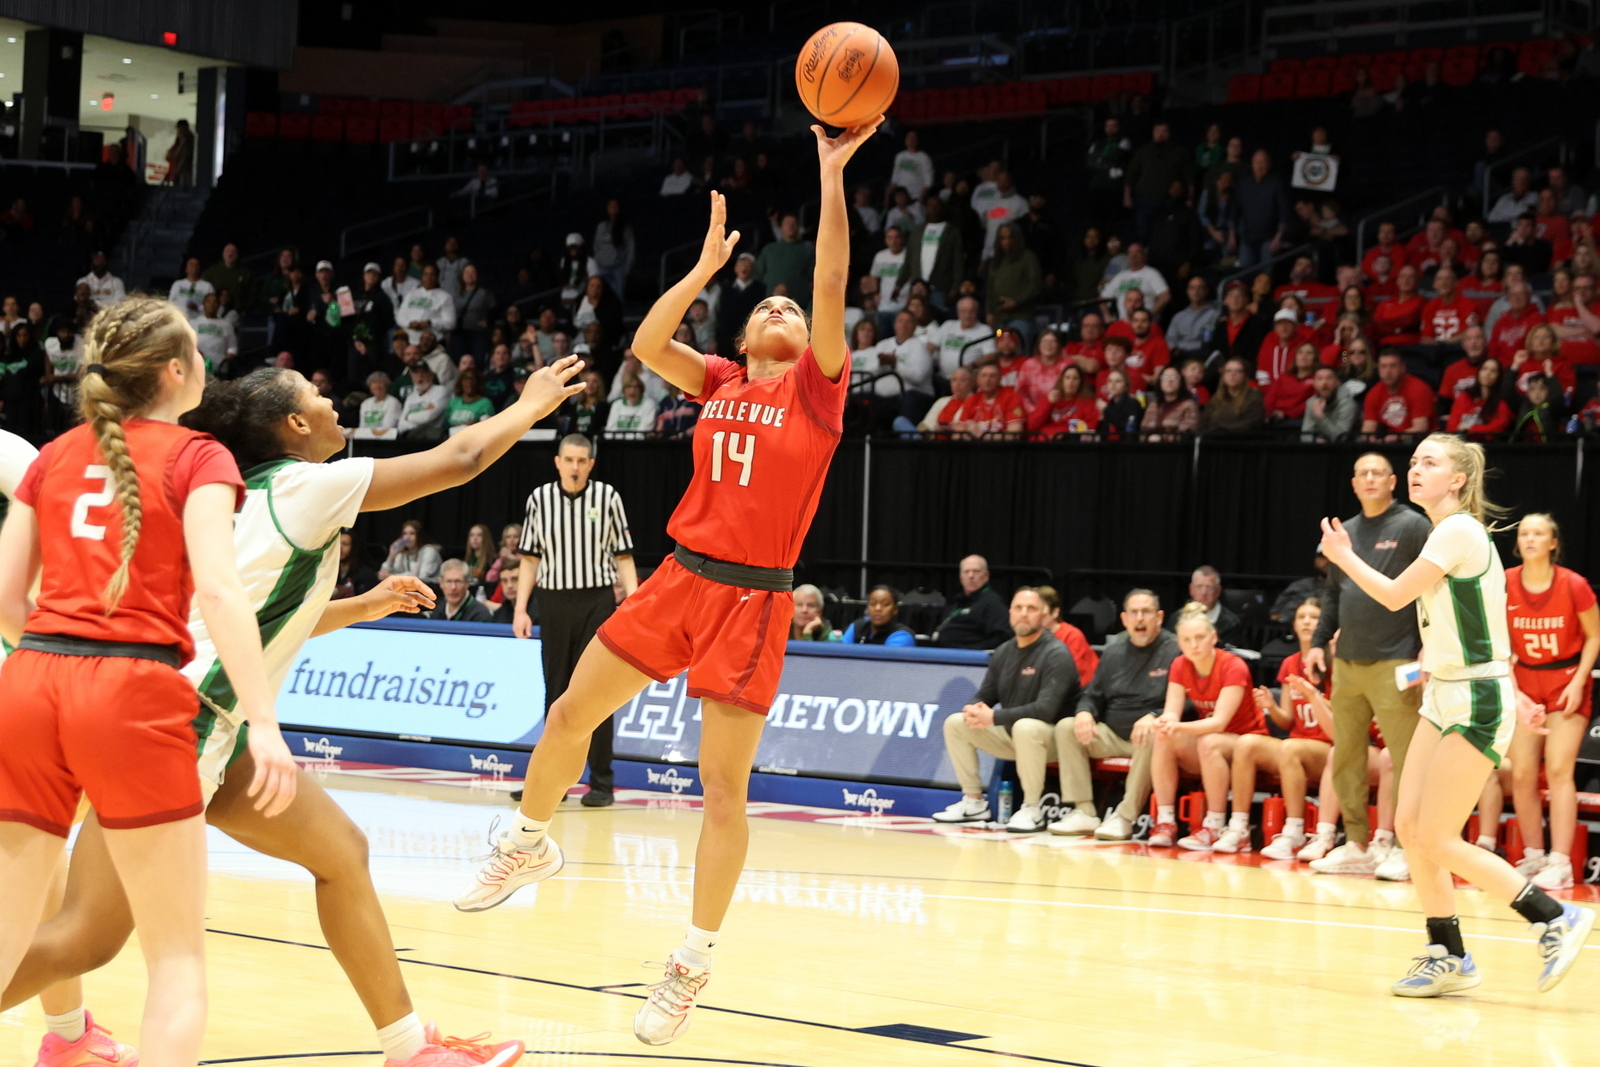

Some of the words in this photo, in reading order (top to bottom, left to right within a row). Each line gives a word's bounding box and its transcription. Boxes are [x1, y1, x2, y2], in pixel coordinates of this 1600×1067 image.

[700, 399, 786, 428] BELLEVUE
[711, 431, 756, 487] 14
[70, 464, 117, 541] 2
[1512, 615, 1565, 630] BELLEVUE
[1522, 633, 1560, 659] 24
[287, 657, 498, 719] fundraising.
[660, 768, 695, 793] Kroger
[857, 788, 896, 813] Kroger
